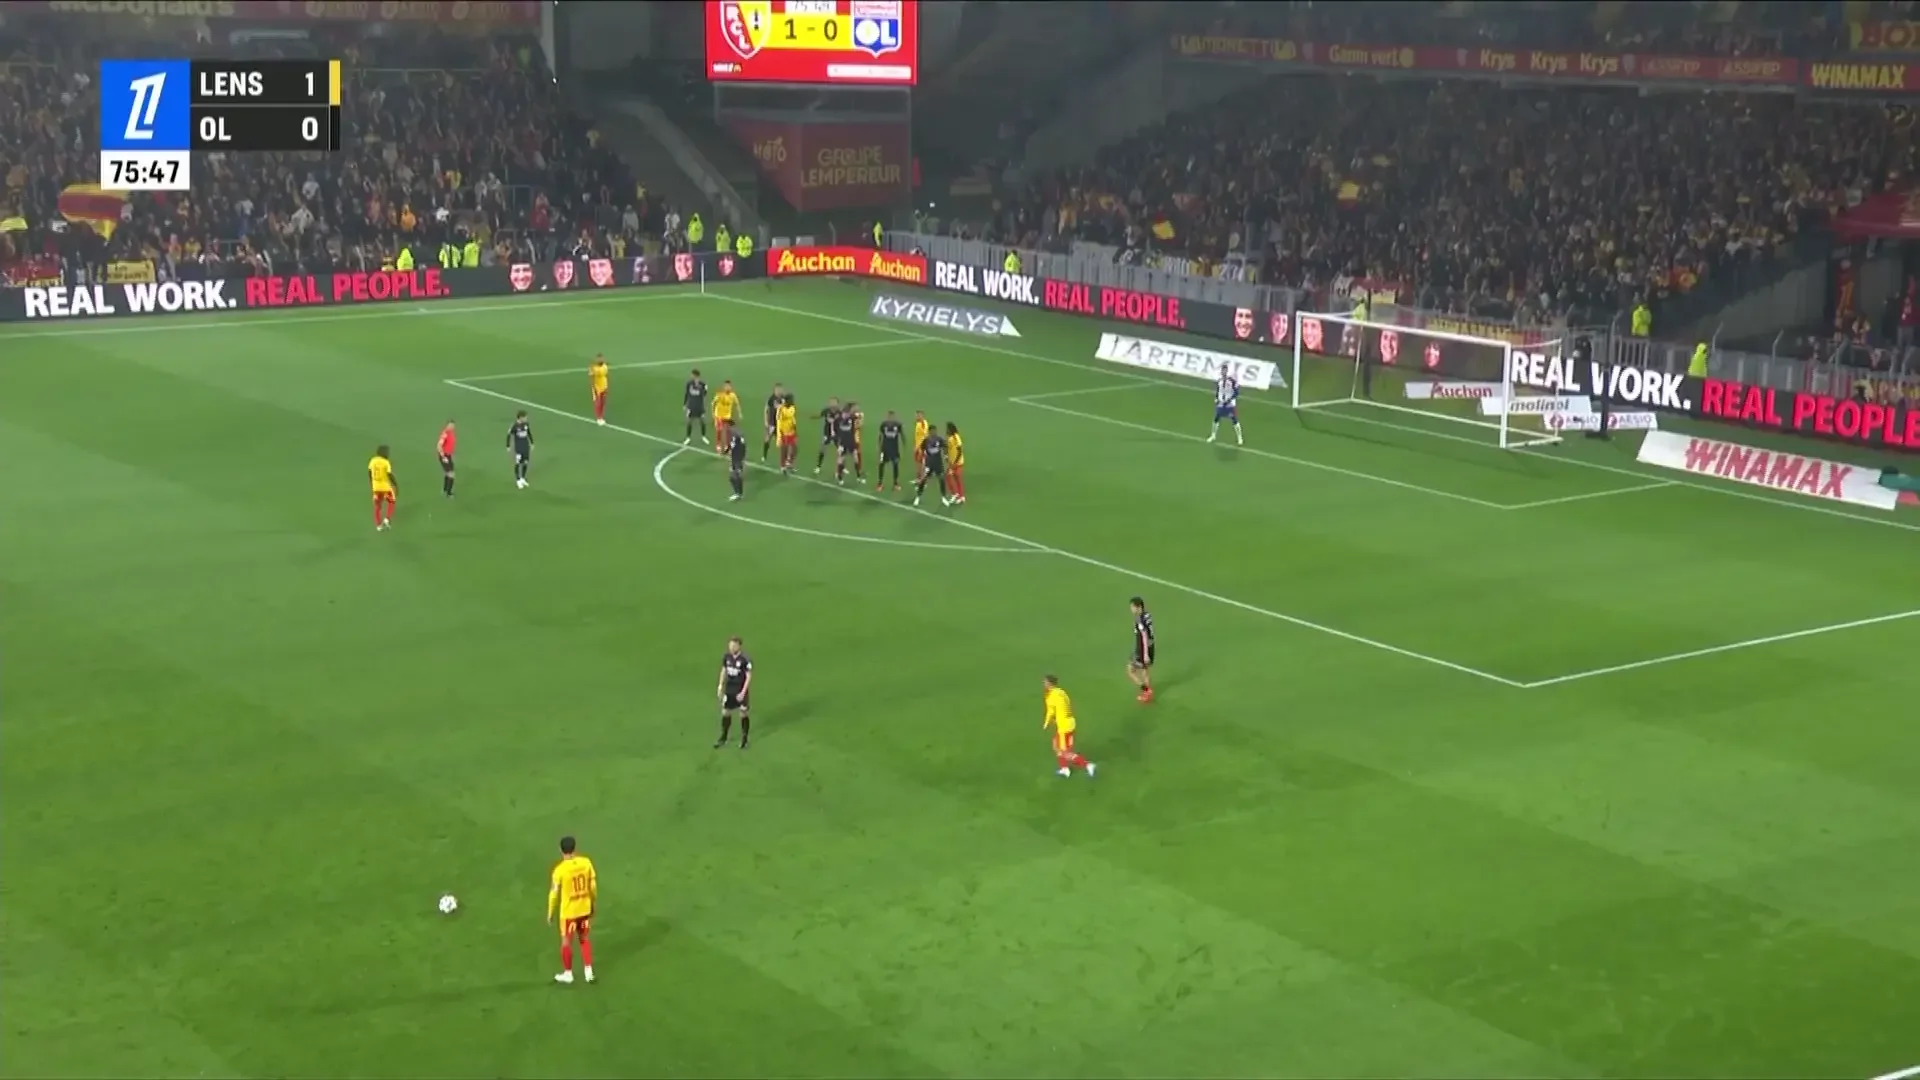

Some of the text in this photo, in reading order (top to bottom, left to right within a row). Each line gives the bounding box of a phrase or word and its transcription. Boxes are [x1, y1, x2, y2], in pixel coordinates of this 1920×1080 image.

[784, 18, 798, 40] 1
[823, 19, 839, 41] 0
[855, 18, 897, 46] OL
[1480, 48, 1516, 71] Krys
[1530, 51, 1568, 75] Krys
[1580, 52, 1620, 76] Krys
[1811, 62, 1907, 88] WINAMAX
[778, 250, 856, 273] Auchan
[869, 252, 921, 281] Auchan
[24, 268, 450, 318] REAL WORK. REAL PEOPLE.
[935, 260, 1187, 328] REAL WORK. REAL PEOPLE.
[872, 295, 999, 336] KYRIELYS
[1124, 339, 1261, 383] ARTEMIS
[1430, 381, 1492, 401] Auchan
[1510, 350, 1581, 392] REAL
[1591, 361, 1692, 410] WORK.
[1701, 378, 1782, 426] REAL
[1685, 437, 1853, 499] WINAMAX
[572, 873, 586, 892] 10
